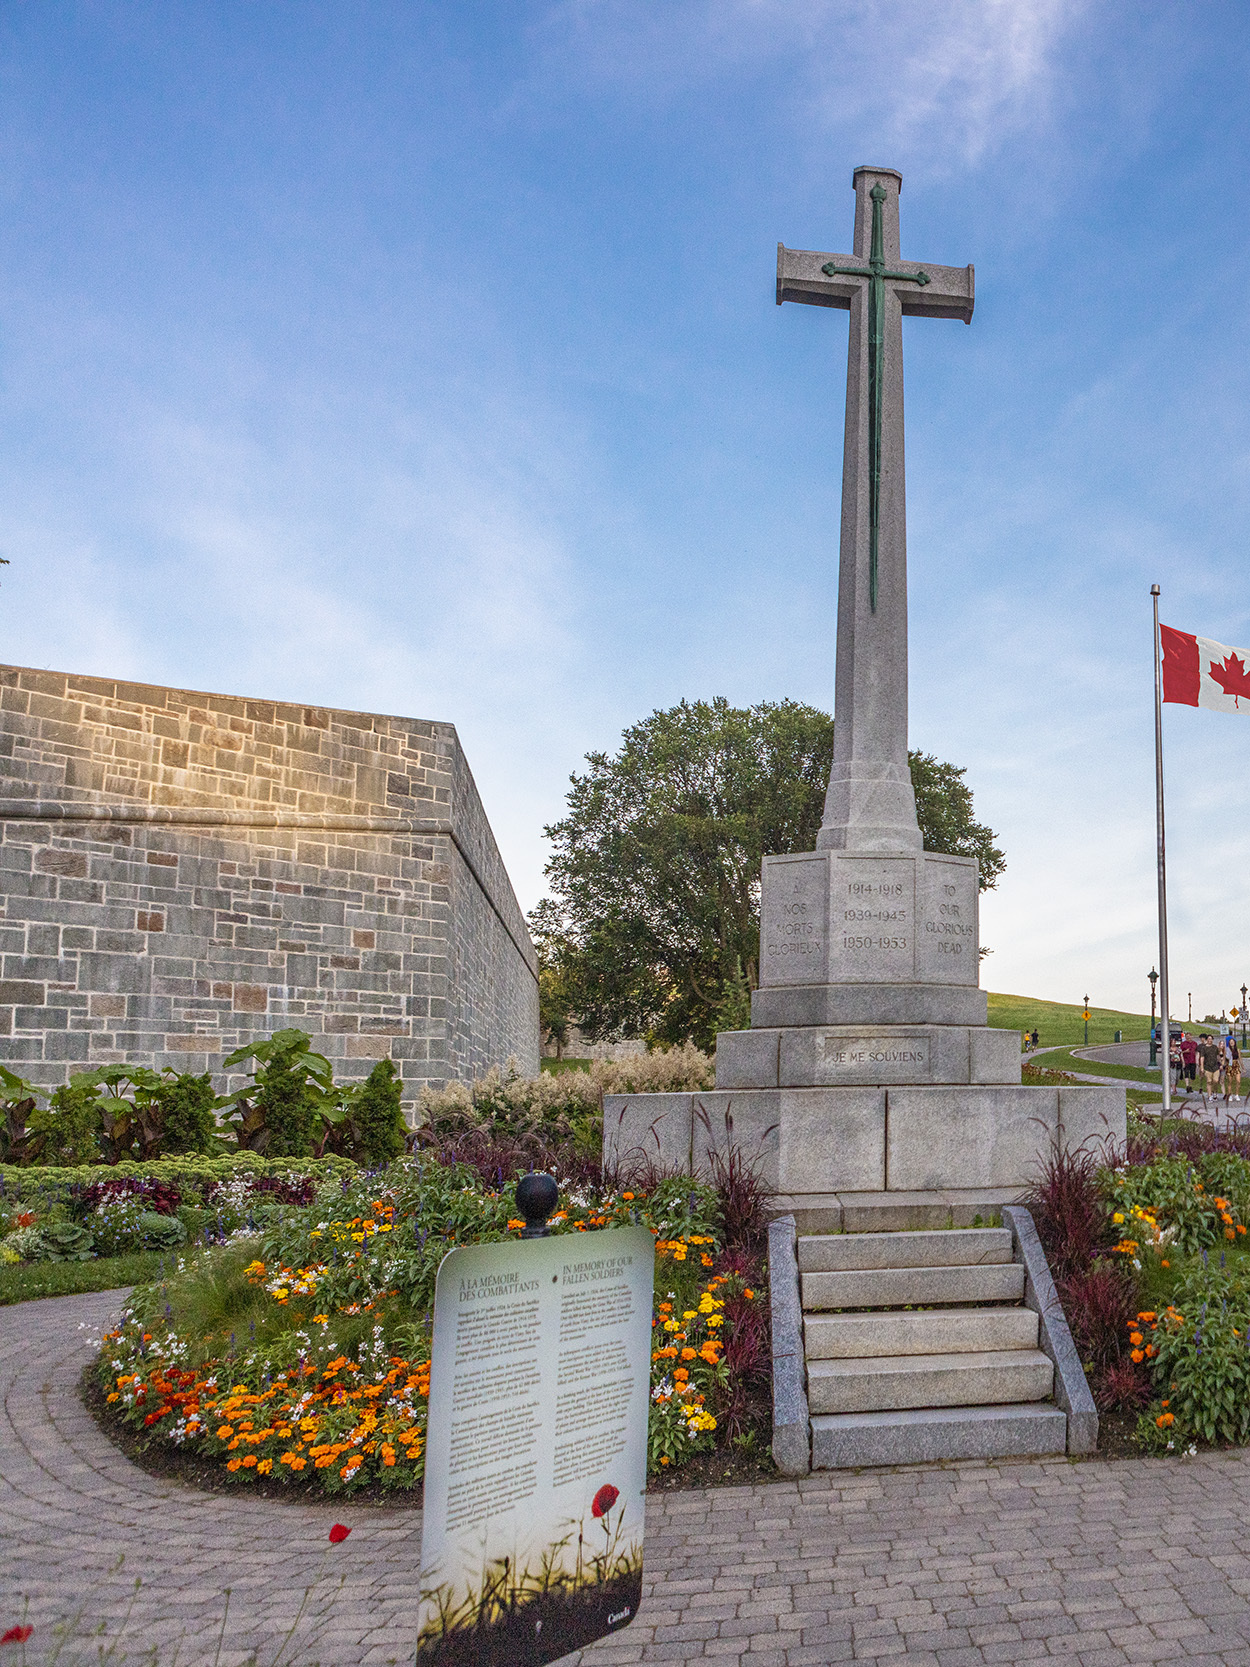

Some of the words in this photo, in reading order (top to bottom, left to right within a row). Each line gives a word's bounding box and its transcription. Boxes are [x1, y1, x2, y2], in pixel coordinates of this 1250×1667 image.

[848, 883, 903, 896] 1914-1918
[943, 884, 956, 897] TO
[783, 902, 807, 915] NOS
[939, 903, 961, 917] OUR
[844, 909, 907, 922] 1939-1945
[925, 921, 974, 936] GLORIOUS
[767, 941, 821, 956] GLORIEUX
[843, 936, 907, 949] 1950-1953
[937, 942, 963, 955] DEAD
[833, 1052, 847, 1063] JE
[850, 1052, 865, 1062] ME
[868, 1051, 924, 1062] SOUVIENS
[562, 1264, 572, 1275] IN
[573, 1259, 605, 1273] MEMORY
[606, 1258, 616, 1269] OF
[467, 1278, 478, 1290] LA
[479, 1271, 520, 1288] MÉMOIRE
[562, 1271, 590, 1285] FALLEN
[591, 1267, 625, 1281] SOLDIERS
[459, 1289, 476, 1302] DES
[477, 1280, 540, 1299] COMBATTANTS
